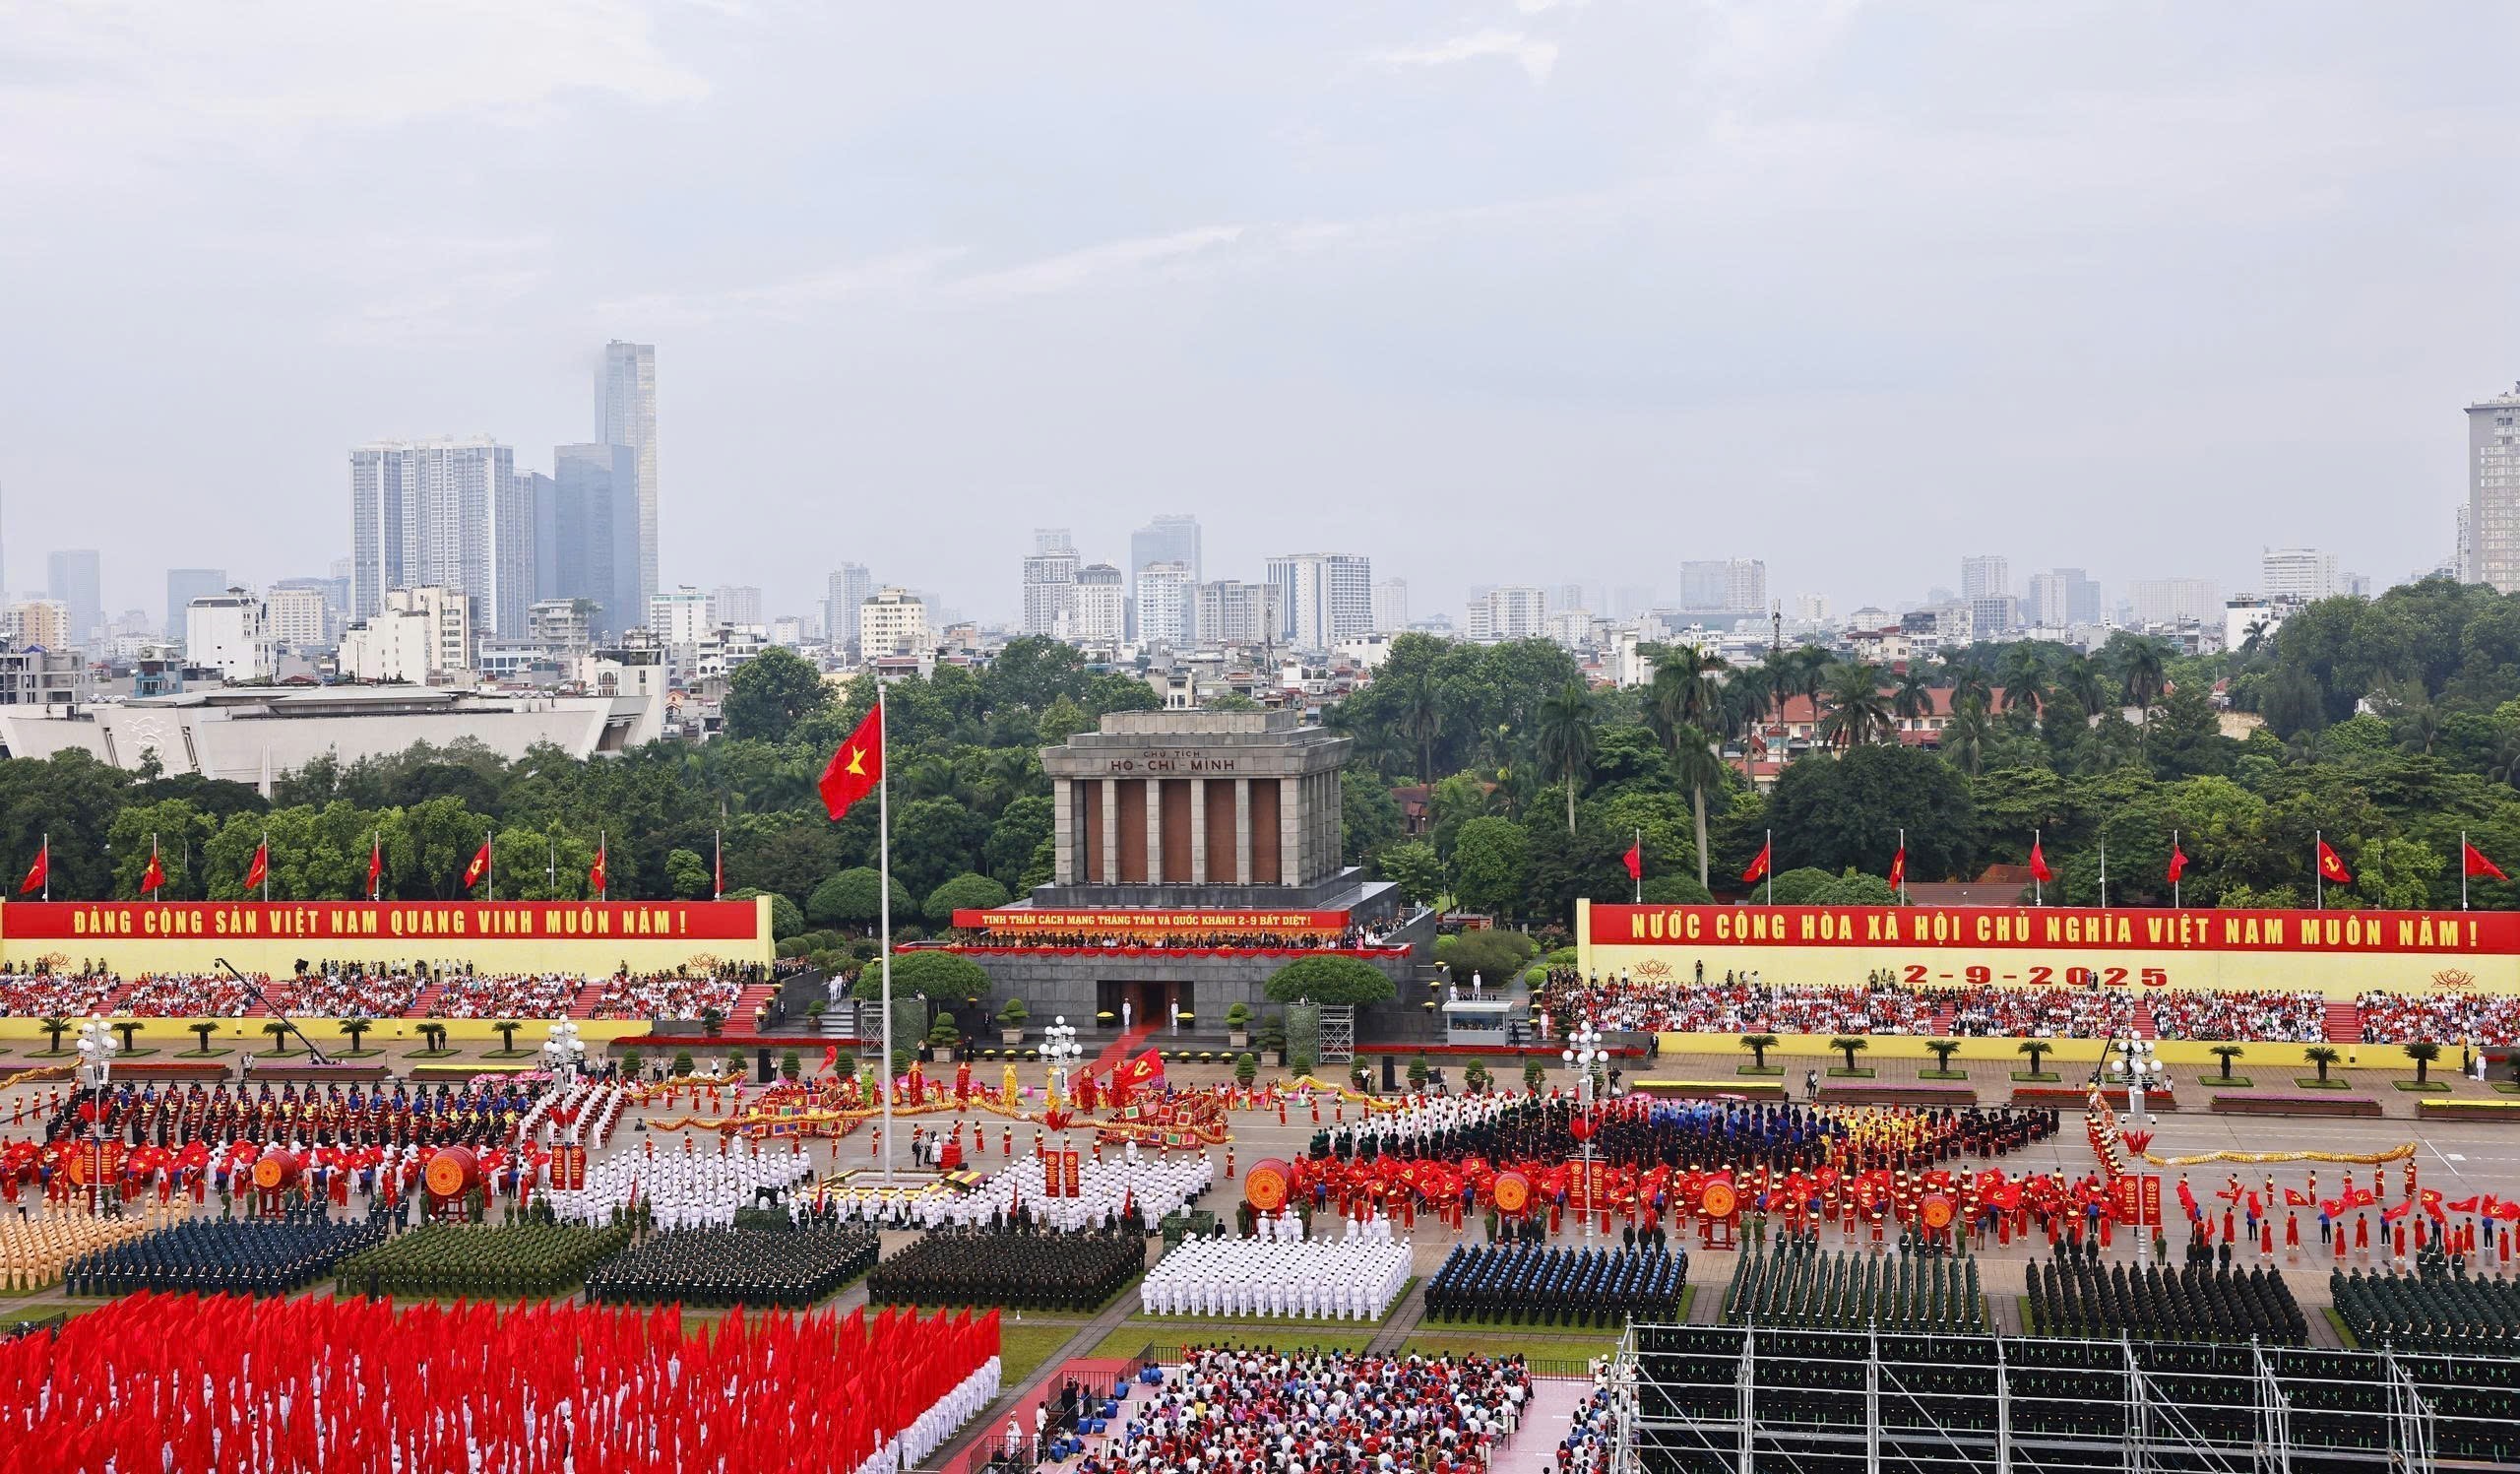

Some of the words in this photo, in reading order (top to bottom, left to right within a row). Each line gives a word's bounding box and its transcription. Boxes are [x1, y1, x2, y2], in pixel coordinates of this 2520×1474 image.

[74, 905, 131, 933] ĐẢNG
[144, 907, 203, 937] CỘNG
[215, 905, 257, 933] SẢN
[270, 907, 319, 937] VIỆT
[331, 910, 377, 933] NAM
[390, 910, 466, 935] QUANG
[478, 910, 533, 933] VINH
[545, 906, 609, 933] MUÔN
[981, 915, 1007, 925] TINH
[1038, 914, 1065, 925] CÁCH
[1066, 915, 1096, 927] MẠNG
[1097, 914, 1131, 926] THÁNG
[1132, 914, 1156, 926] TÁM
[1157, 914, 1171, 926] VÀ
[1172, 913, 1199, 927] QUỐC
[1201, 914, 1236, 926] KHÁNH
[1237, 916, 1257, 926] 2-9
[1259, 913, 1281, 926] BẤT
[1631, 909, 1700, 939] NƯỚC
[1716, 910, 1786, 943] CỘNG
[1801, 911, 1853, 940] HÒA
[1867, 911, 1899, 940] XÃ
[1915, 911, 1960, 945] HỘI
[1977, 910, 2030, 942] CHỦ
[2047, 913, 2132, 943] NGHĨA
[2147, 913, 2209, 947] VIỆT
[2225, 918, 2284, 944] NAM
[2300, 914, 2381, 945] MUÔN
